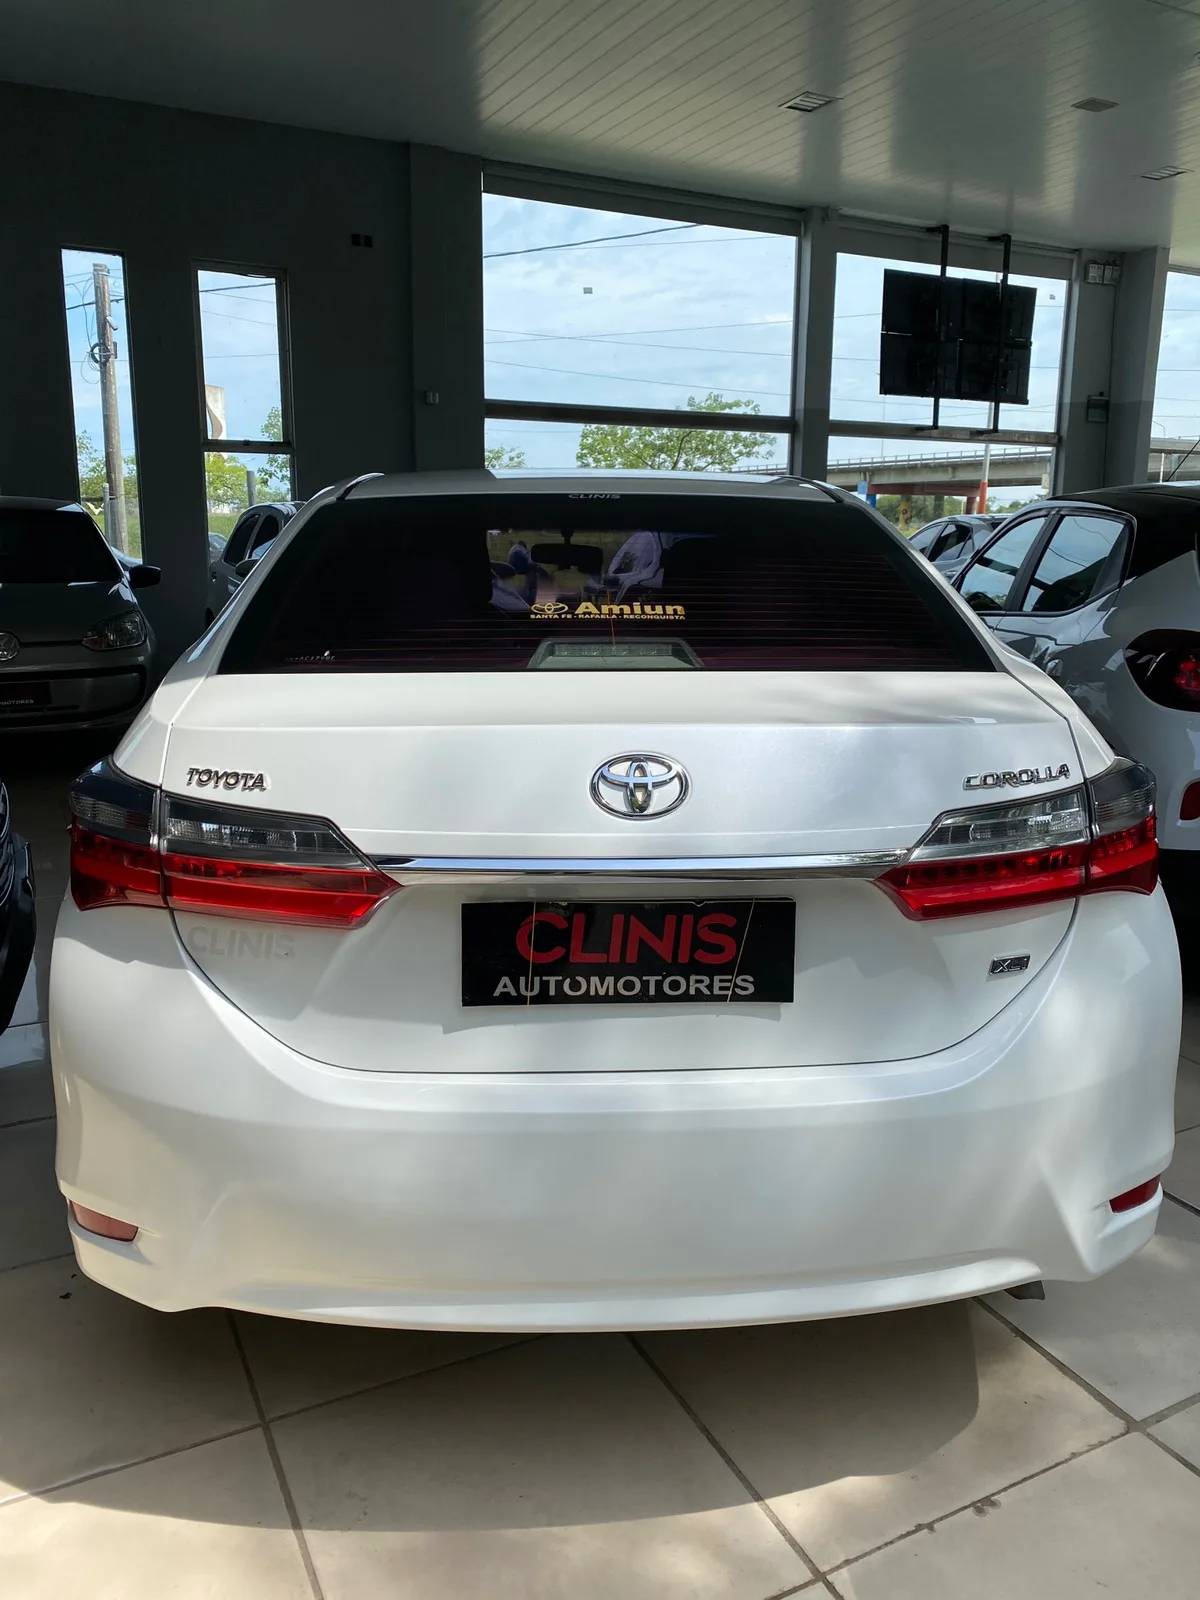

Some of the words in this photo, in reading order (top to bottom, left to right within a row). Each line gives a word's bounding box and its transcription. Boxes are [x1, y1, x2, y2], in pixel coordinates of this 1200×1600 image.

[574, 602, 686, 615] Amiun
[187, 768, 267, 792] TOYOTA
[963, 764, 1070, 790] COROLLA
[187, 926, 295, 960] CLINIS
[516, 912, 738, 965] CLINIS
[493, 974, 756, 997] AUTOMOTORES
